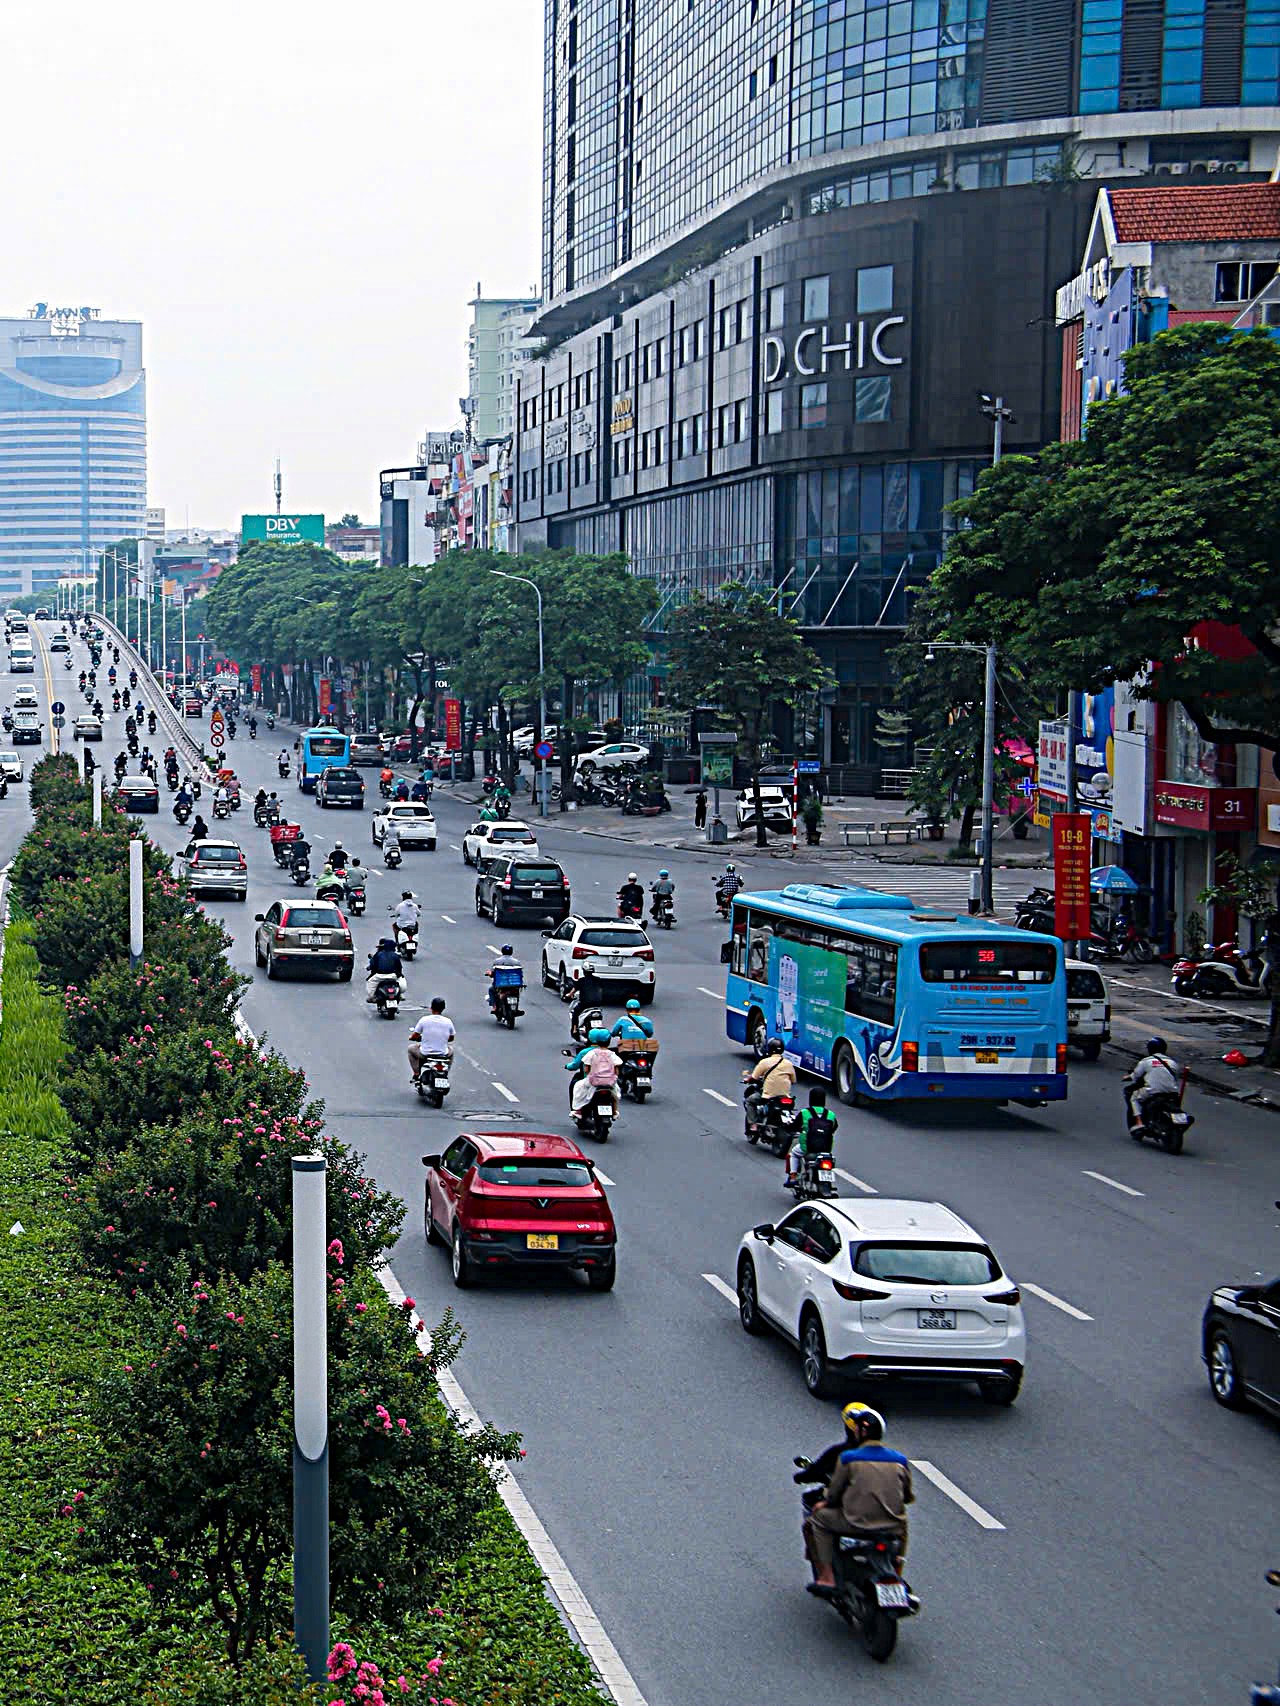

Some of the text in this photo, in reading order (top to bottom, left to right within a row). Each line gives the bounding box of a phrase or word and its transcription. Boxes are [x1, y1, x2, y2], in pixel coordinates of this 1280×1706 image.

[764, 316, 904, 383] D.CHIC
[266, 518, 300, 531] DBV
[1224, 800, 1241, 813] 31
[1061, 830, 1083, 843] 19-8
